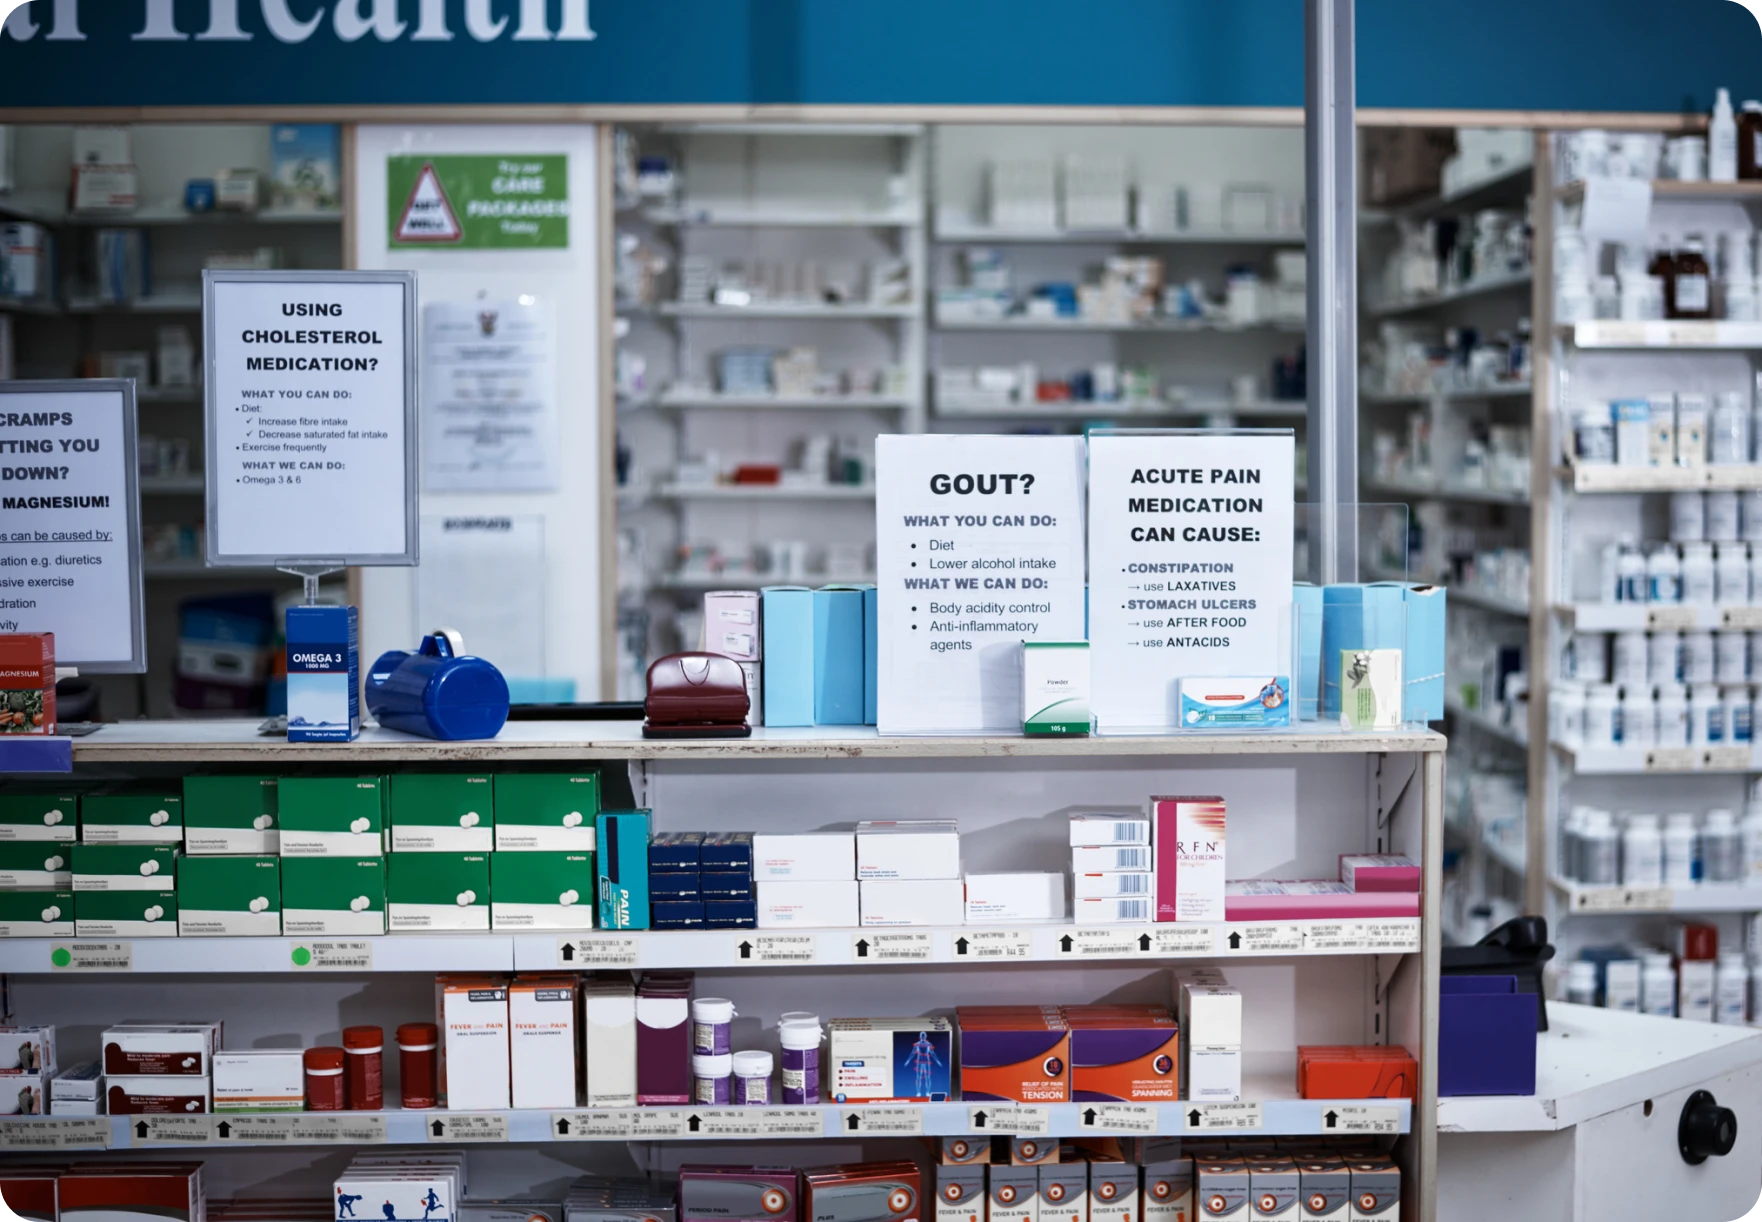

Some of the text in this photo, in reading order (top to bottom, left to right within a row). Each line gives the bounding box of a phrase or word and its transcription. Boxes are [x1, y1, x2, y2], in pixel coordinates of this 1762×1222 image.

[282, 303, 343, 317] USING
[241, 330, 383, 344] CHOLESTEROL
[246, 357, 378, 371] MEDICATION?
[241, 390, 352, 399] WHAT YOU CAN DO:
[241, 404, 262, 413] Diet:
[258, 417, 348, 426] Increase fibre intake
[258, 430, 388, 439] Decrease saturated fat intake
[59, 438, 100, 452] YOU
[242, 443, 327, 453] Exercise frequently
[242, 461, 345, 470] WHAT WE CAN DO:
[2, 466, 69, 480] DOWN?
[1131, 469, 1260, 484] ACUTE PAIN
[242, 476, 301, 485] Omega 3 & 6
[930, 473, 1035, 495] GOUT?
[2, 495, 110, 510] MAGNESIUM!
[1128, 498, 1263, 513] MEDICATION
[903, 515, 1057, 527] WHAT YOU CAN DO:
[10, 532, 32, 541] can
[35, 530, 49, 541] be
[52, 530, 93, 541] caused
[96, 529, 113, 542] by:
[1130, 527, 1260, 542] CAN CAUSE:
[929, 540, 954, 551] Diet
[30, 557, 52, 569] e.g.
[55, 555, 102, 565] diuretics
[929, 558, 1057, 569] Lower alcohol intake
[1128, 563, 1234, 573] CONSTIPATION
[27, 577, 74, 587] exercise
[904, 578, 1048, 589] WHAT WE CAN DO:
[1143, 581, 1236, 591] use LAXATIVES
[930, 602, 1050, 615] Body acidity control
[1127, 599, 1256, 610] STOMACH ULCERS
[930, 620, 1038, 633] Anti-inflammatory
[1143, 617, 1247, 628] use AFTER FOOD
[930, 639, 972, 652] agents
[1143, 637, 1230, 647] use ANTACIDS
[293, 653, 342, 662] OMEGA 3
[620, 889, 630, 926] PAIN
[1022, 1091, 1063, 1099] TENSION
[1132, 1089, 1173, 1097] SPANNING
